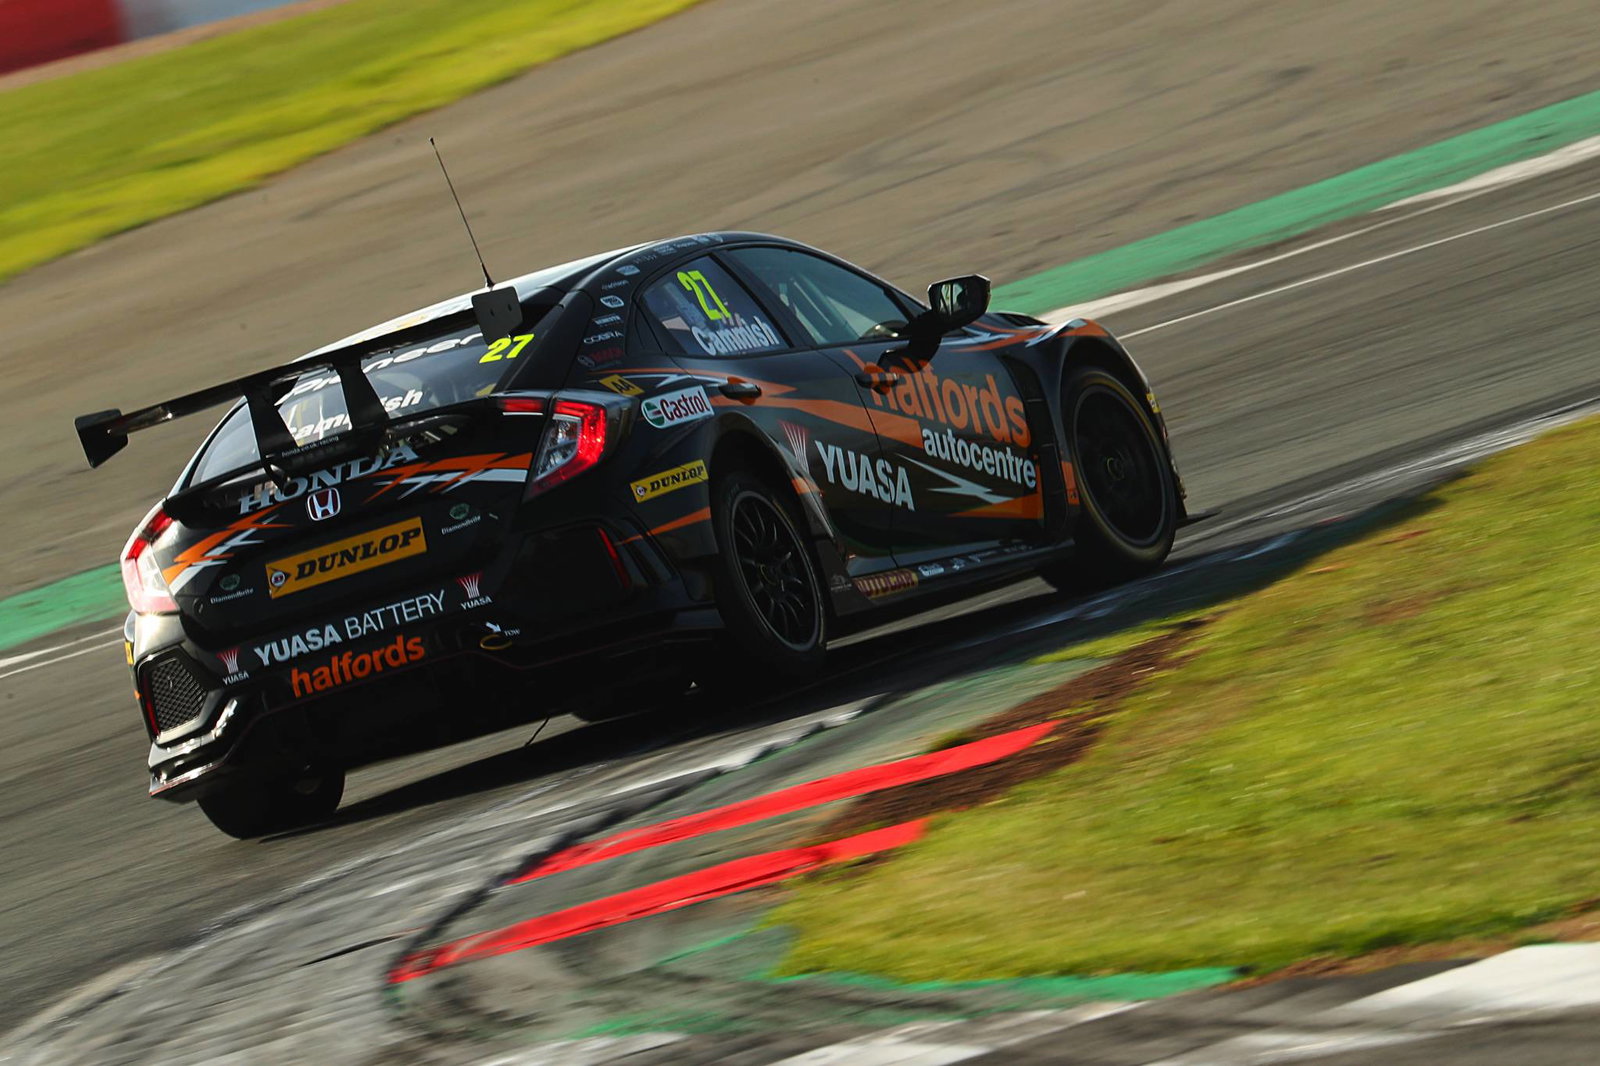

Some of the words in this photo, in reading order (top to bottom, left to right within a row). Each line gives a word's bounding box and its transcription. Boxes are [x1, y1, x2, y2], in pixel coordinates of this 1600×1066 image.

[677, 270, 732, 320] 27
[479, 333, 535, 364] 27
[691, 315, 780, 356] Cammish
[611, 379, 634, 393] AA
[660, 390, 711, 421] Castrol
[238, 445, 420, 514] HONDA
[649, 465, 705, 492] DUNLOP
[815, 440, 916, 512] YUASA
[922, 428, 1037, 489] autocentre
[294, 527, 421, 581] DUNLOP
[461, 596, 493, 611] YUASA
[254, 624, 343, 667] YUASA
[344, 589, 446, 639] BATTERY
[223, 671, 250, 687] YUASA
[291, 634, 426, 698] halfords
